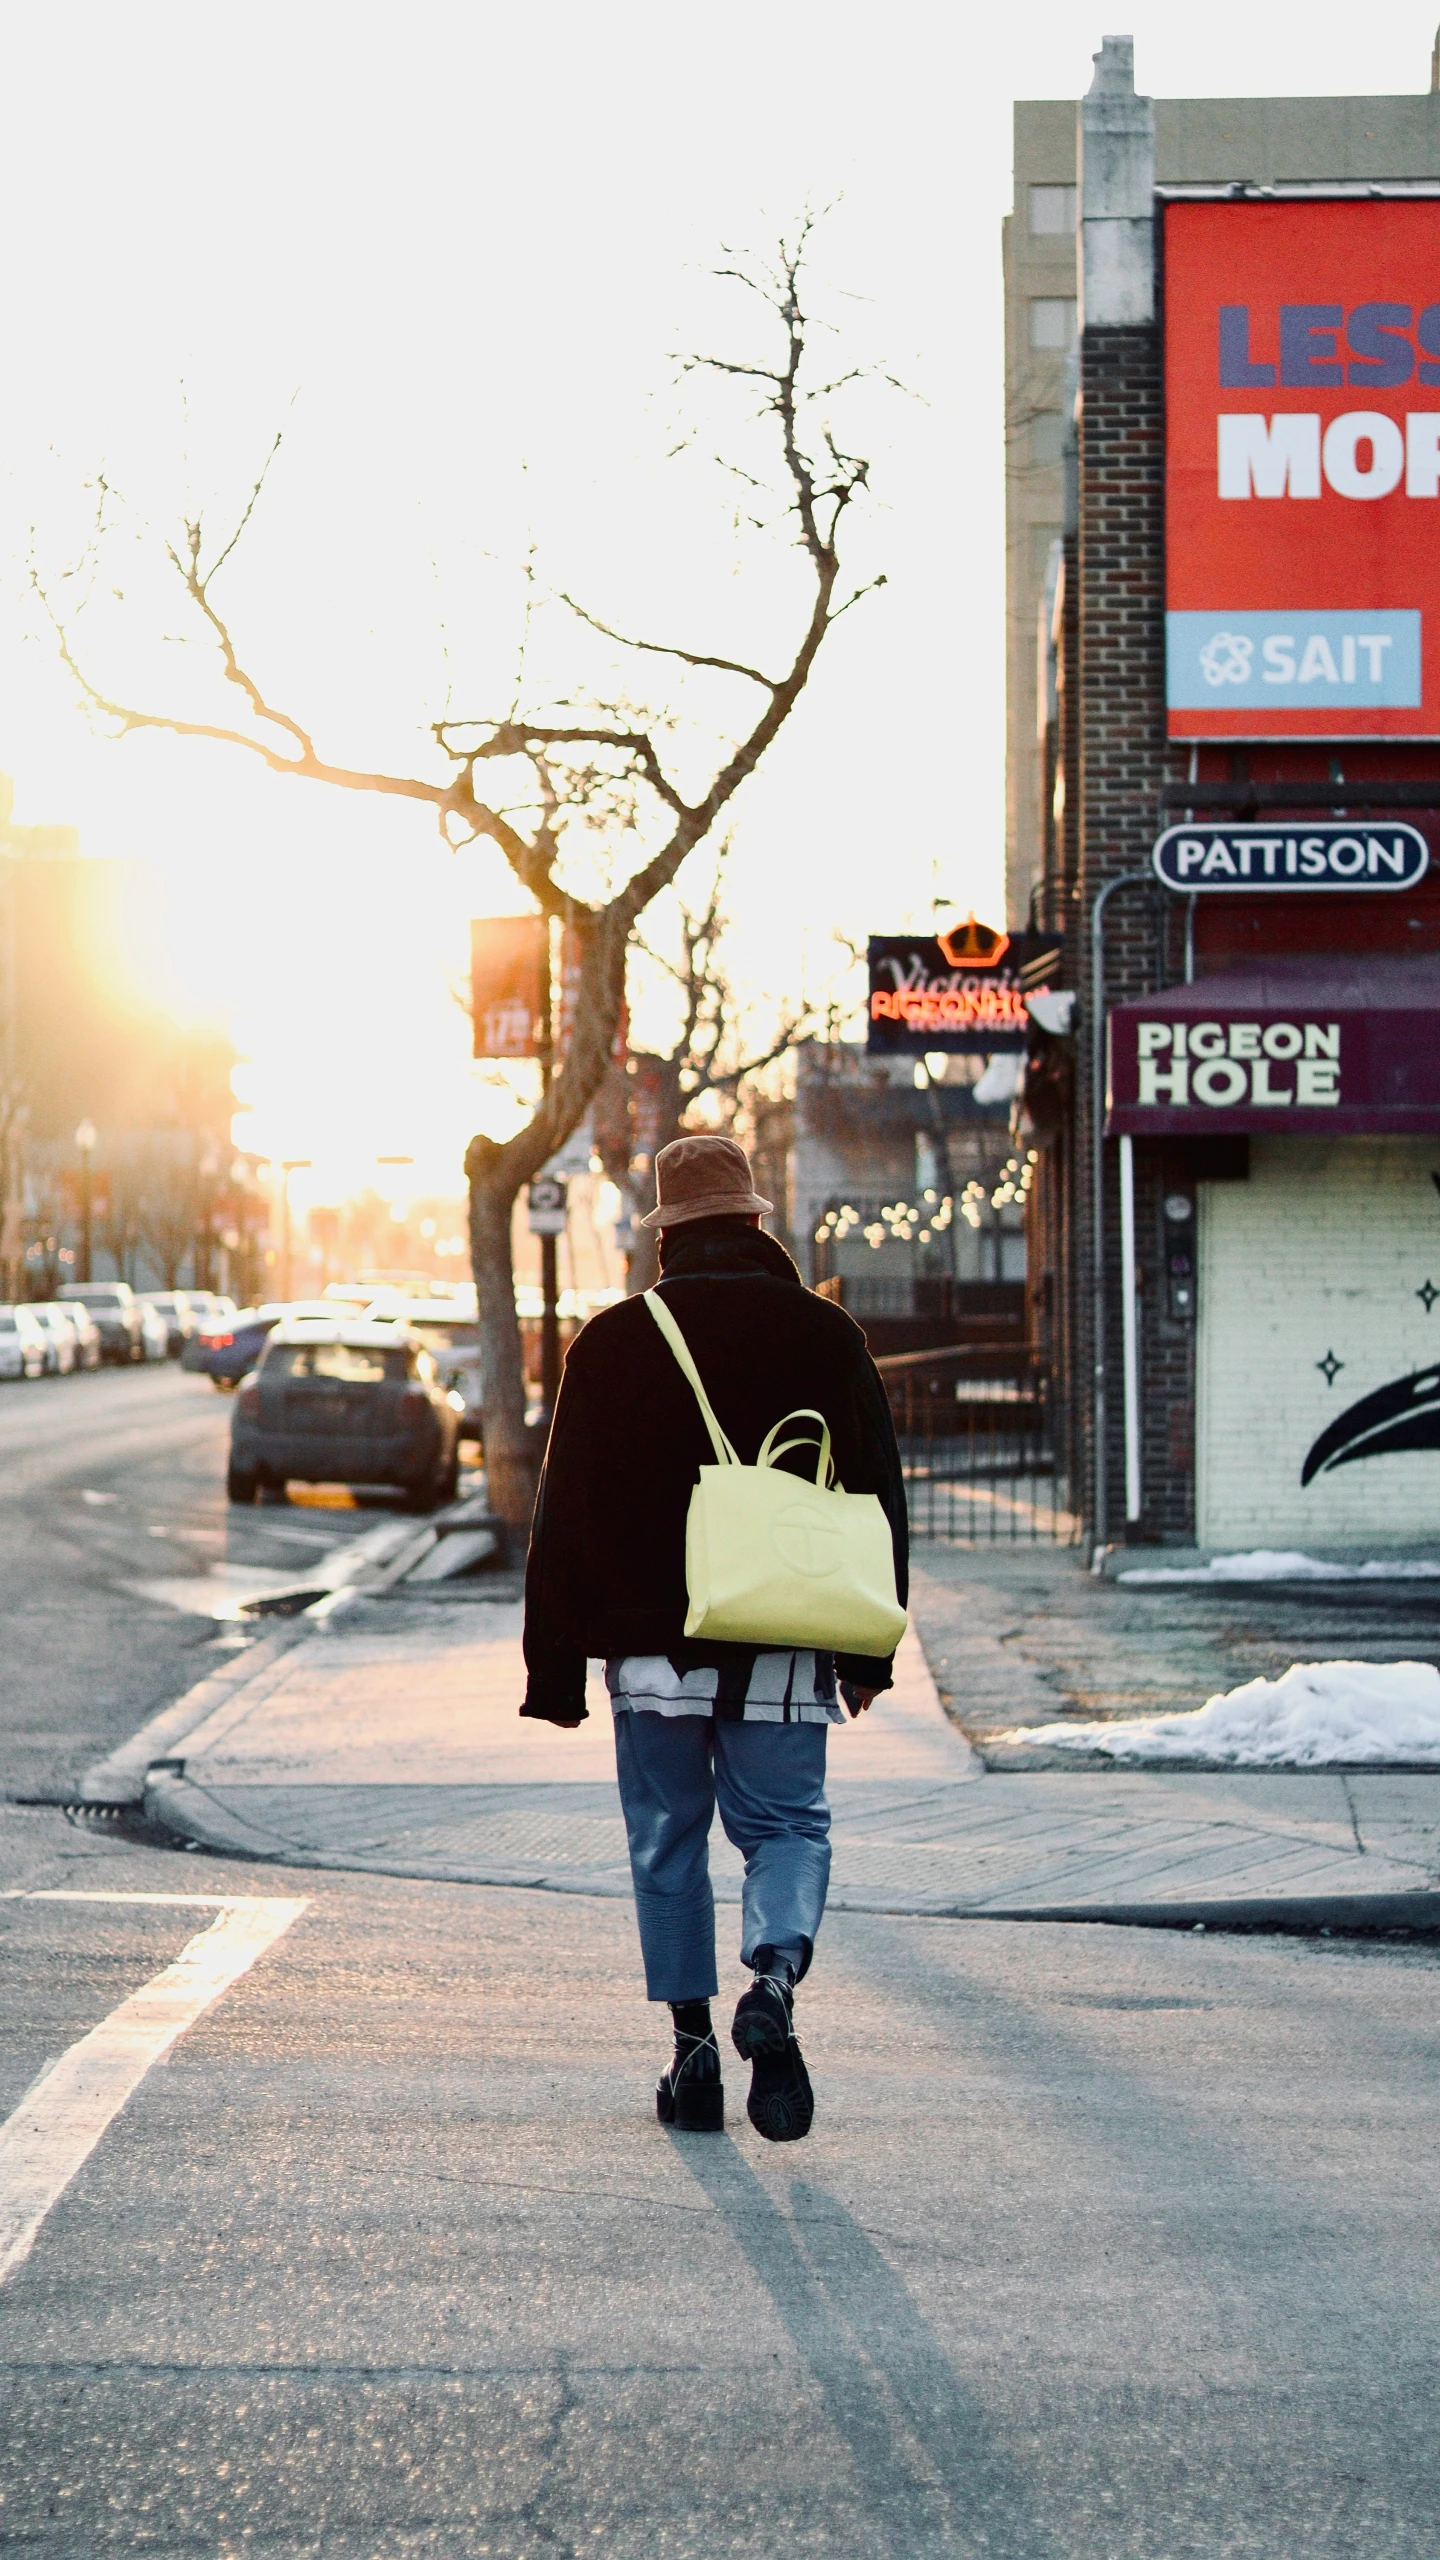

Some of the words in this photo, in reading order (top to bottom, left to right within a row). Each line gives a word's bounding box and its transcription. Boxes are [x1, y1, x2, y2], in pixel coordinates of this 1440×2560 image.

[1262, 634, 1393, 684] SAIT
[1177, 837, 1404, 876] PATTISON
[1137, 1022, 1341, 1060] PIGEON
[1137, 1057, 1341, 1107] HOLE
